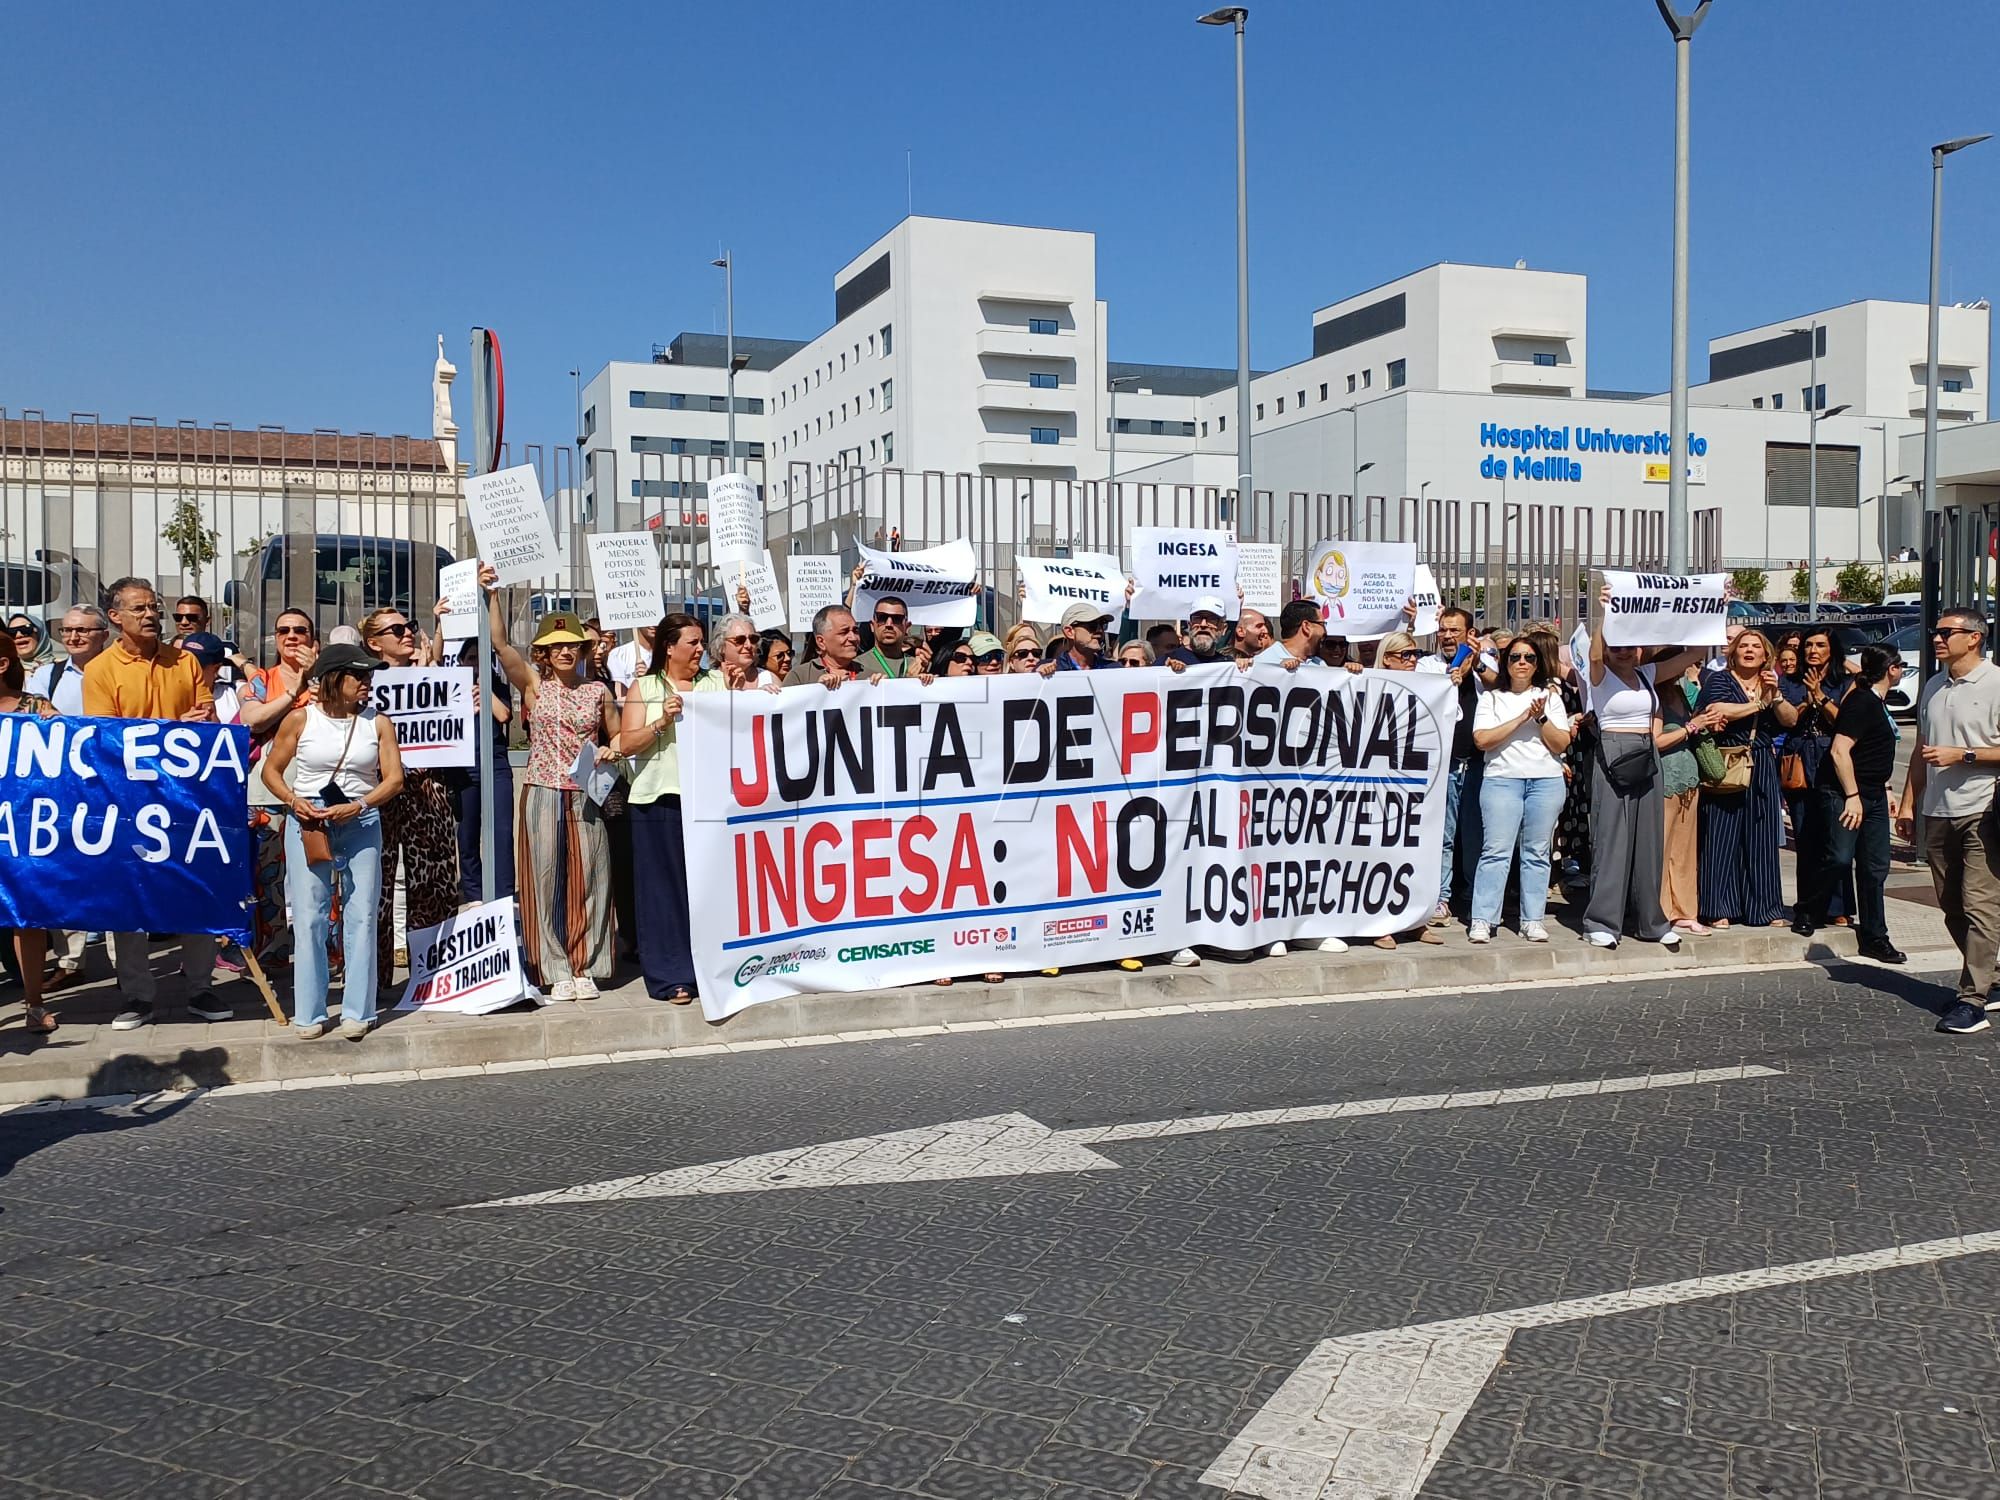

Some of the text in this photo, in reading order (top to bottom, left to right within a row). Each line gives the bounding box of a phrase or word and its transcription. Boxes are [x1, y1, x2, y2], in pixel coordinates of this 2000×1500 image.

[1480, 422, 1708, 457] Hospital Universitio
[1480, 454, 1582, 482] de Melilla
[482, 476, 517, 490] PARA LA
[480, 485, 525, 501] PLANTILLA
[490, 505, 523, 519] ABUSO Y
[503, 526, 520, 535] LOS
[489, 532, 540, 549] DESPACHOS
[535, 541, 542, 550] Y
[596, 538, 648, 550] ¡JUNQUERA!
[608, 549, 640, 558] MENOS
[1158, 542, 1218, 557] INGESA
[604, 559, 633, 568] FOTOS
[607, 568, 646, 579] GESTIÓN
[1044, 565, 1105, 580] INGESA
[1159, 574, 1220, 588] MIENTE
[605, 590, 646, 600] RESPETO
[1049, 583, 1110, 603] MIENTE
[626, 601, 639, 609] LA
[608, 610, 657, 621] PROFESIÓN
[730, 686, 1429, 807] JUNTA DE PERSONAL
[1055, 796, 1168, 898] NO
[1183, 788, 1227, 851] AL
[1237, 788, 1377, 850] RECORTE
[1380, 791, 1425, 849] DE
[1185, 858, 1415, 928] LOS DERECHOS
[1059, 918, 1093, 932] CCOO
[426, 916, 497, 971] GESTIÓN
[954, 928, 991, 946] UGT
[838, 938, 935, 963] CEMSATSE
[995, 943, 1016, 951] Melilla
[411, 948, 511, 1002] NO ES TRAICIÓN
[766, 965, 777, 975] ES
